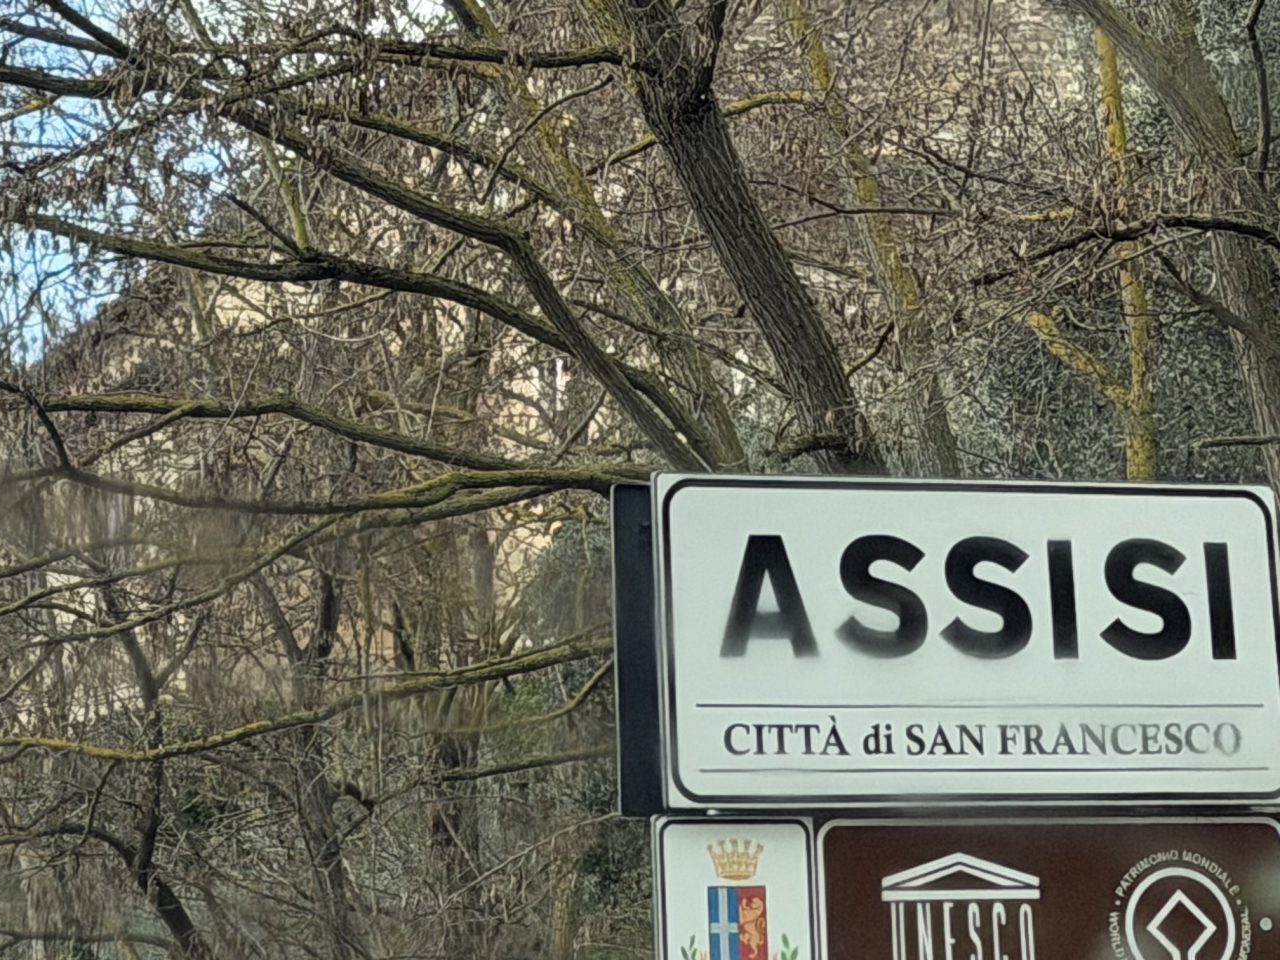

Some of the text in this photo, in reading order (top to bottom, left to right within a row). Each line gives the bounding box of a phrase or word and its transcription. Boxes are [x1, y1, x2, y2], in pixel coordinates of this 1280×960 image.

[719, 533, 1237, 661] ASSISI
[723, 714, 1244, 758] CITTÀ di SAN FRANCESCO
[1182, 849, 1241, 897] MONDIALE
